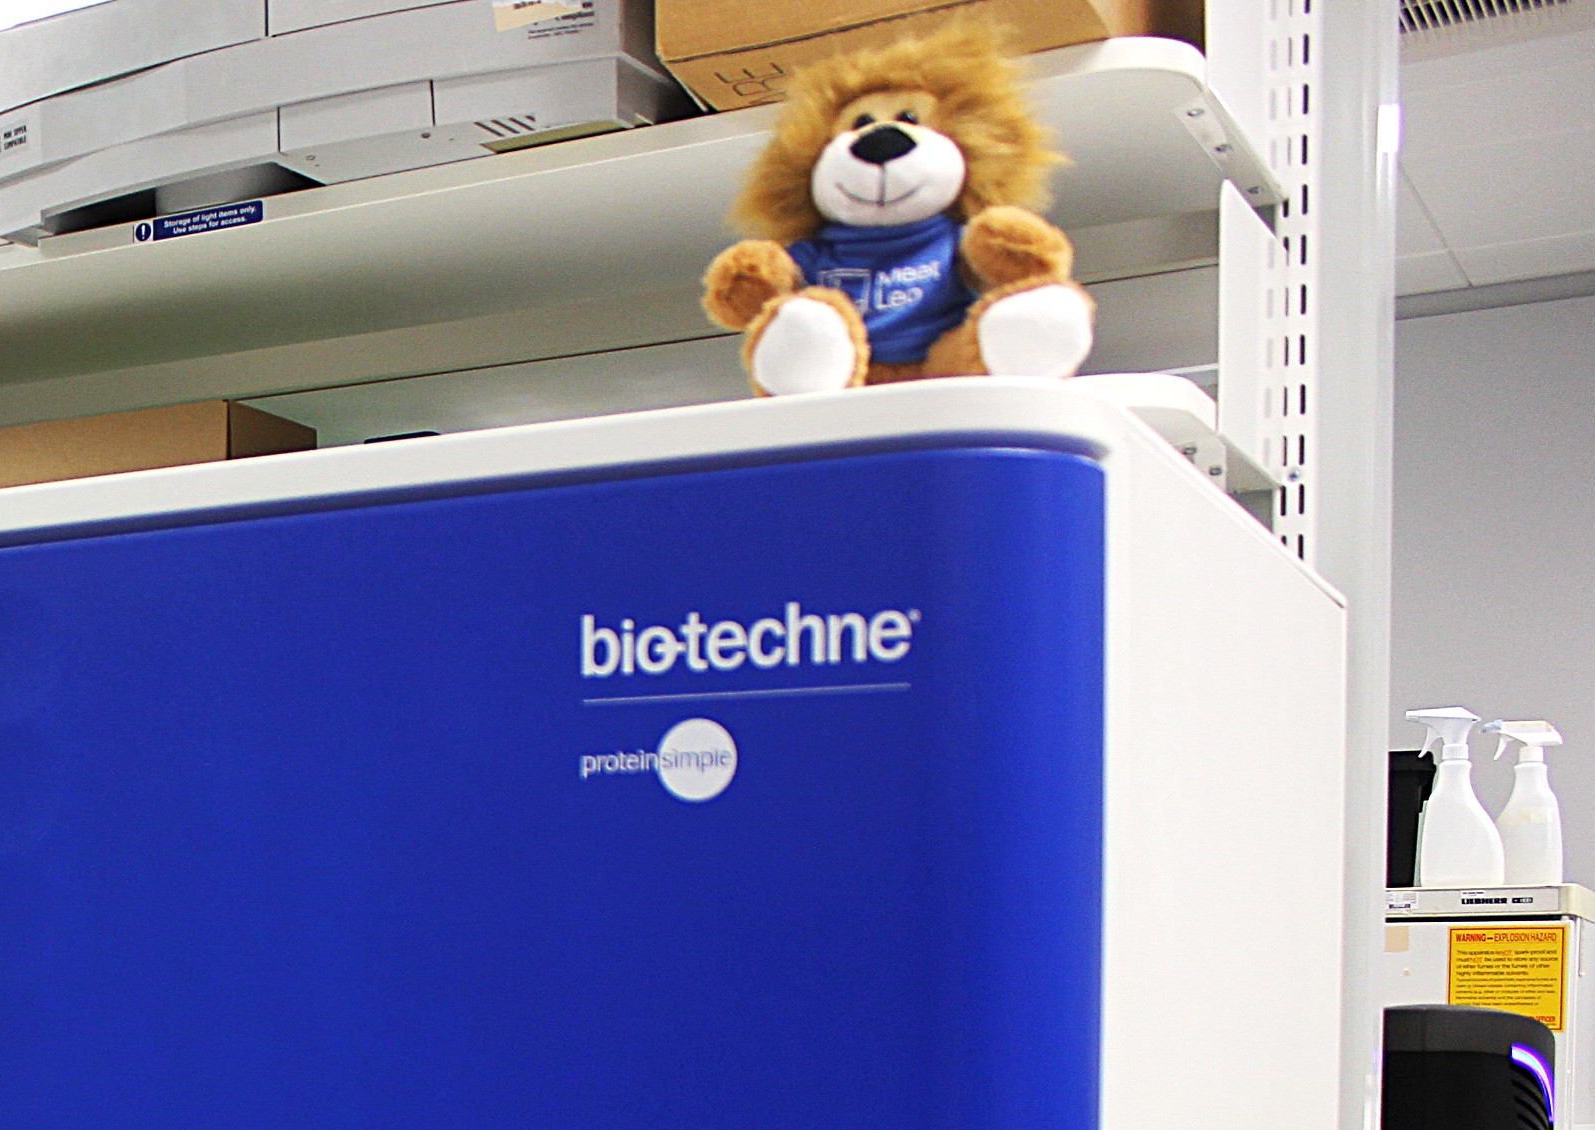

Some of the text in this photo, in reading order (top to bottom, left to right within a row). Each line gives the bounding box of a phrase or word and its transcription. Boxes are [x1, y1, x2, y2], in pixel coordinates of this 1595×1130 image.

[164, 216, 191, 229] Storage
[192, 215, 200, 223] of
[201, 212, 217, 223] light
[218, 208, 238, 219] items
[172, 226, 187, 234] Use
[188, 224, 207, 233] steps
[877, 259, 943, 286] Meet
[877, 285, 924, 311] Leo
[1456, 933, 1486, 942] WARNING
[1494, 932, 1529, 941] EXPLOSION
[1530, 932, 1557, 941] HAZARD
